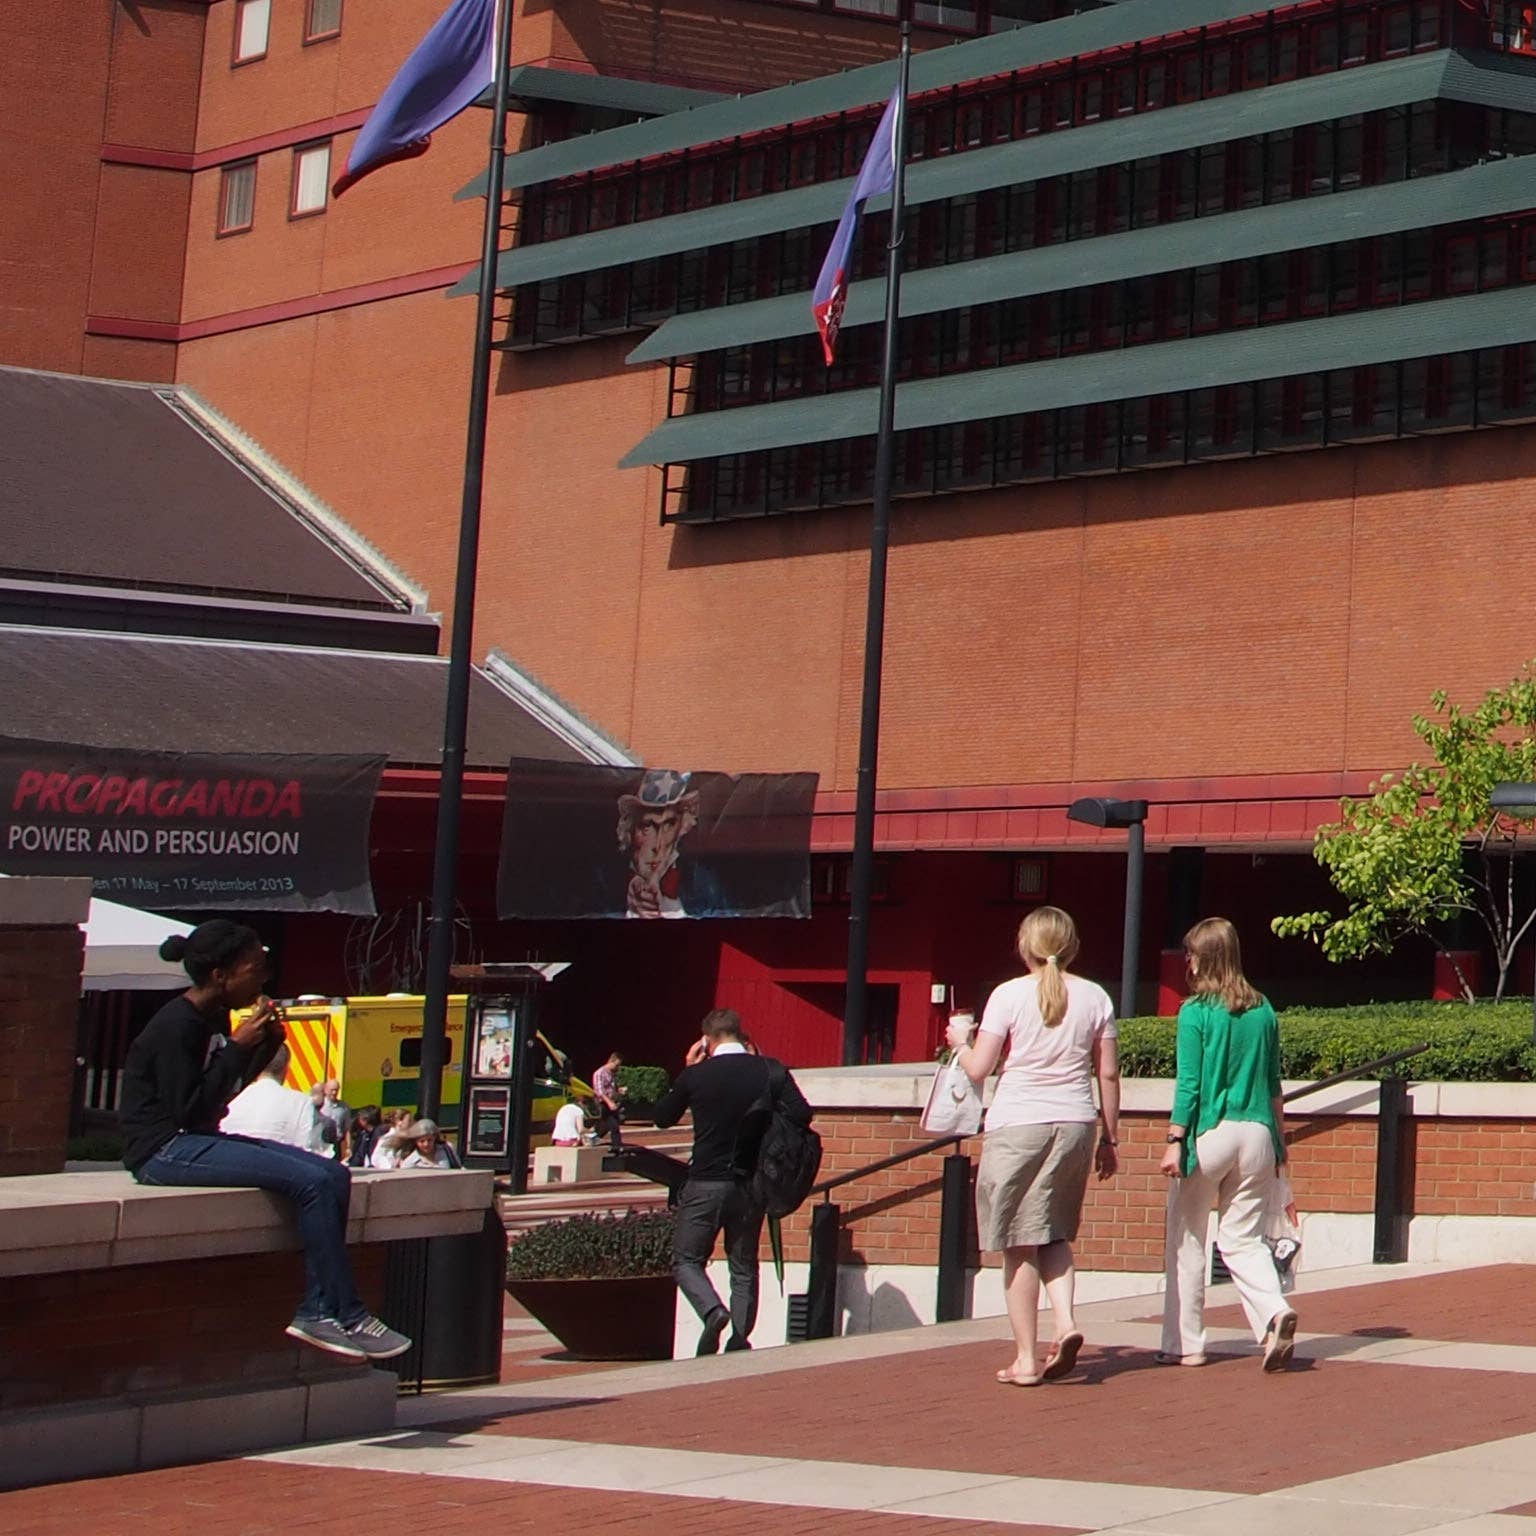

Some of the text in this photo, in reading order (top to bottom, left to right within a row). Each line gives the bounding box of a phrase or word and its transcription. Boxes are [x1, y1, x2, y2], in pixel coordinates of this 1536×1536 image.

[12, 770, 302, 816] PROPAGANDA
[8, 825, 299, 855] POWER AND PERSUASION
[112, 877, 127, 889] 17
[132, 877, 159, 893] May
[173, 877, 188, 890] 17
[191, 877, 257, 894] September
[259, 877, 294, 891] 2013
